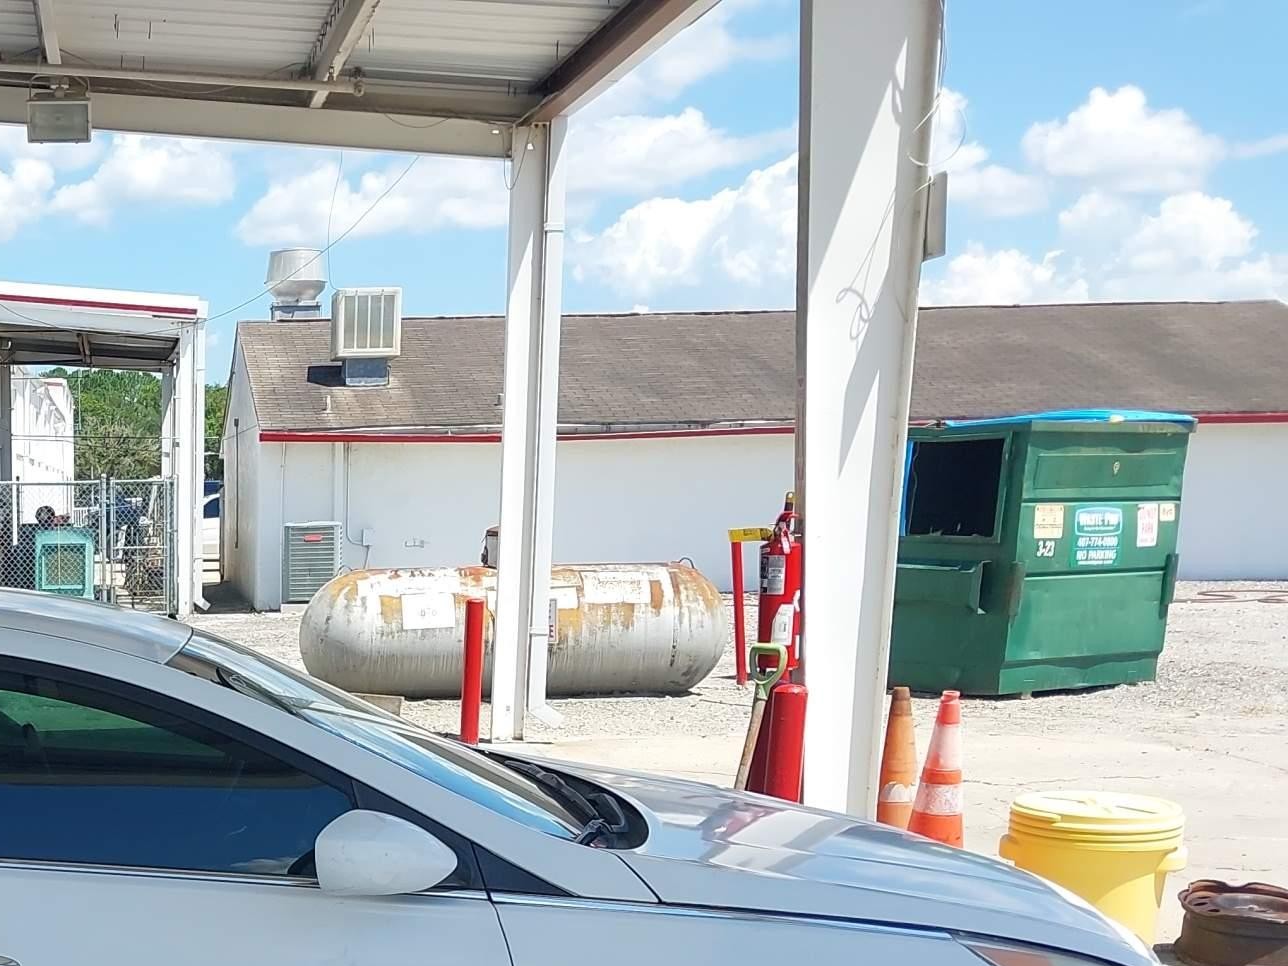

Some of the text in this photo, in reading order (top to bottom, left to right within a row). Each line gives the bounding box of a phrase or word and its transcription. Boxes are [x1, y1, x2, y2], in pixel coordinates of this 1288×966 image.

[1037, 540, 1055, 557] 3-23
[1076, 549, 1117, 560] NO PARKING
